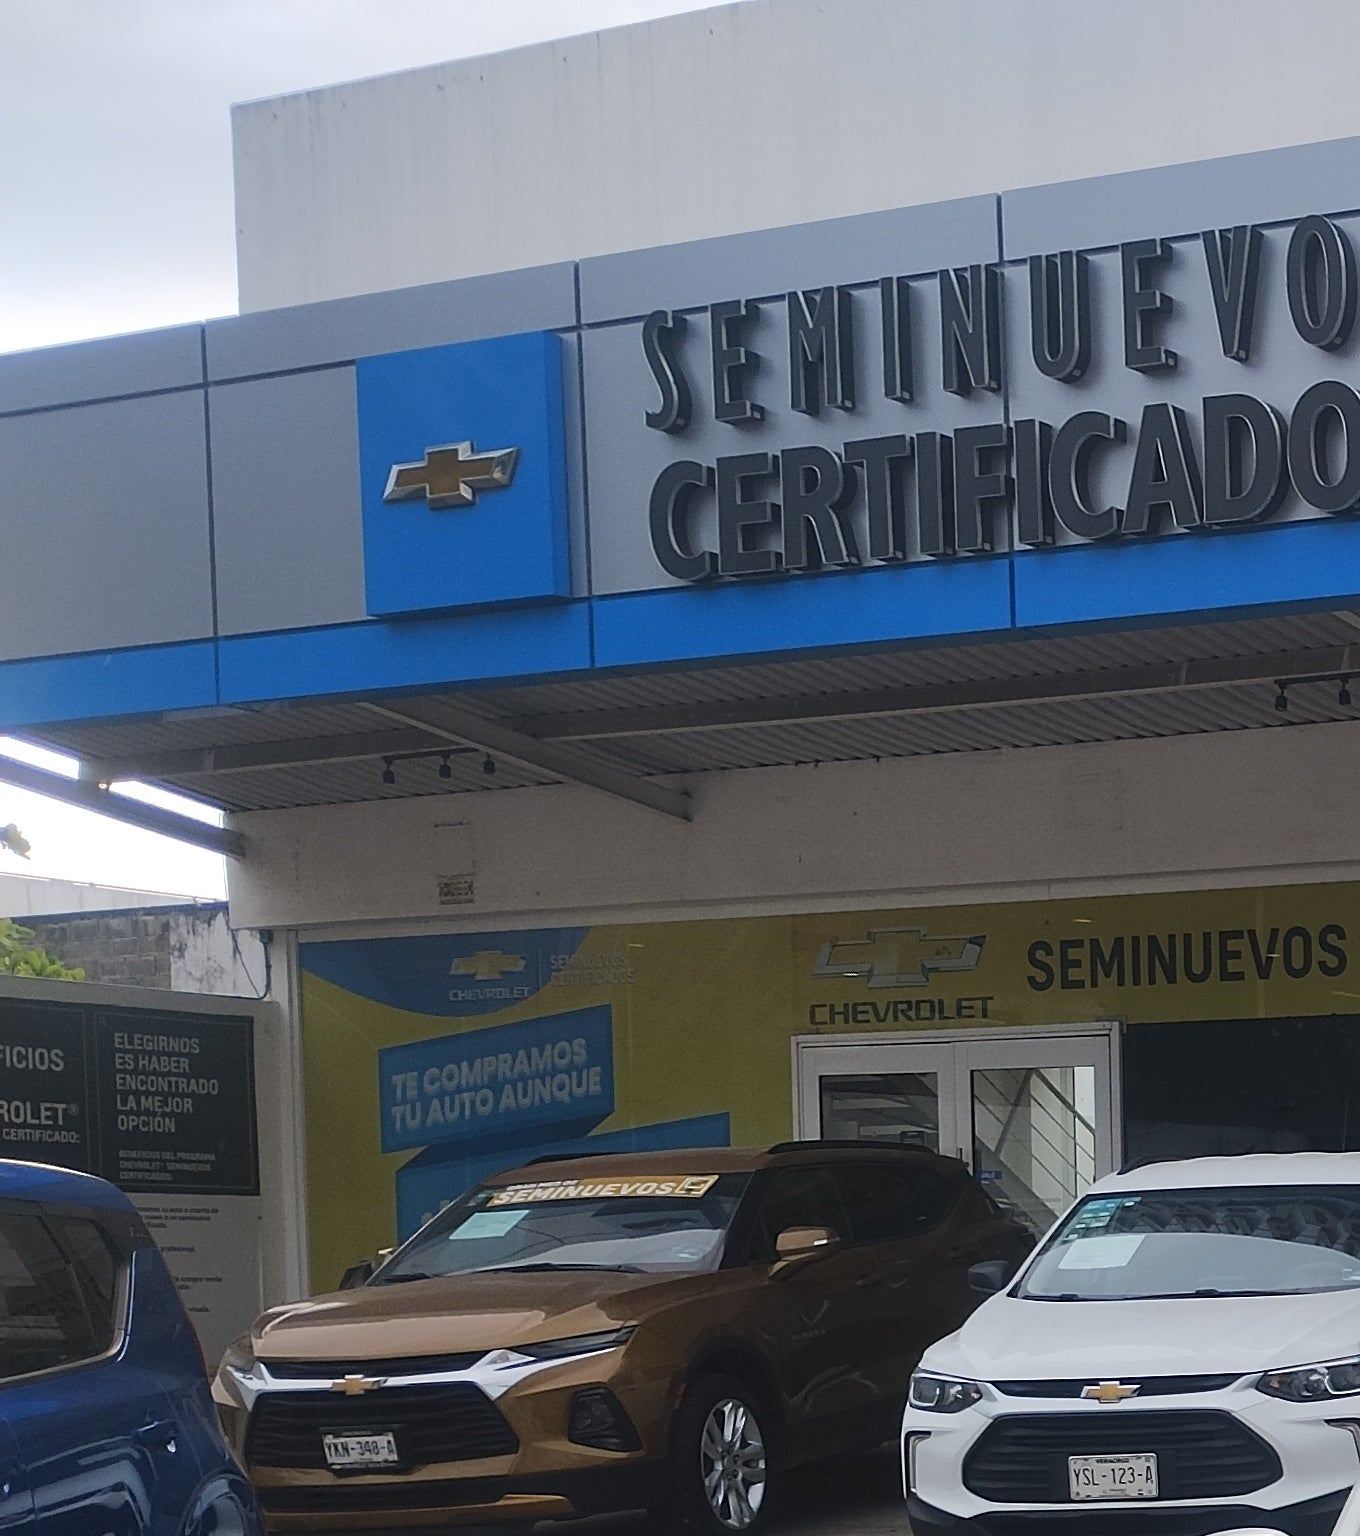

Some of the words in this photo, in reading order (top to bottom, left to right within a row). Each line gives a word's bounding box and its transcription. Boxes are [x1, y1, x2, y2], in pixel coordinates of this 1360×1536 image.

[1027, 923, 1348, 992] SEMINUEVOS
[449, 986, 530, 1002] CHEVROLET
[809, 996, 995, 1026] CHEVROLET
[113, 1032, 200, 1054] ELEGIRNOS
[0, 1044, 65, 1072] ICIOS
[114, 1052, 134, 1070] ES
[138, 1053, 190, 1073] HABER
[391, 1071, 418, 1099] TE
[423, 1037, 587, 1093] COMPRAMOS
[115, 1073, 219, 1095] ENCONTRADO
[117, 1094, 138, 1112] LA
[140, 1096, 194, 1114] MEJOR
[391, 1103, 422, 1131] TU
[426, 1088, 495, 1127] AUTO
[500, 1066, 602, 1108] AUNQUE
[117, 1110, 176, 1133] OPCIÓN
[2, 1128, 80, 1144] CERTIFICADO:
[493, 1181, 674, 1205] SEMINUEVOS
[1073, 1465, 1154, 1486] YSL-123-A
